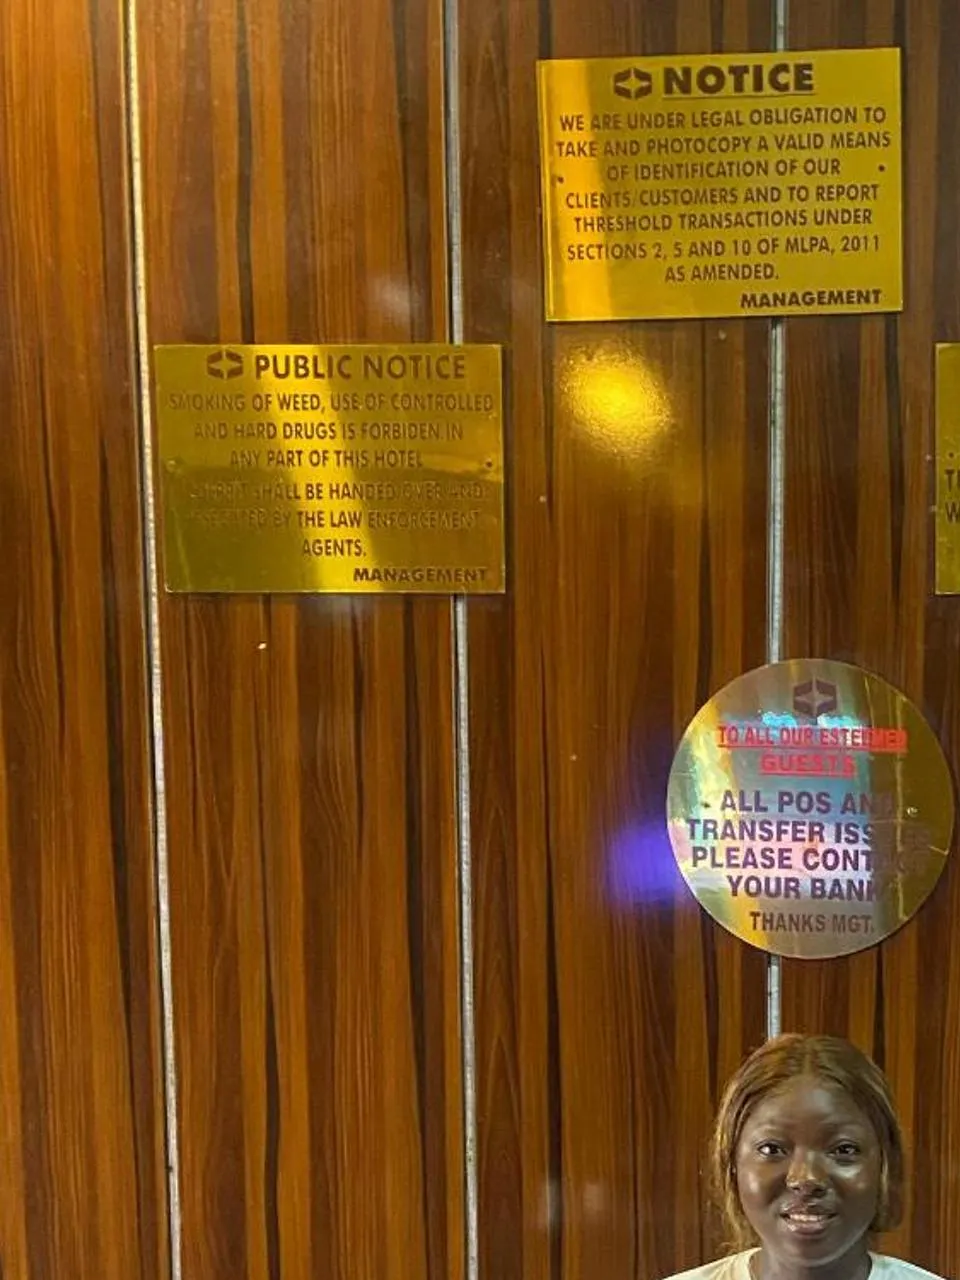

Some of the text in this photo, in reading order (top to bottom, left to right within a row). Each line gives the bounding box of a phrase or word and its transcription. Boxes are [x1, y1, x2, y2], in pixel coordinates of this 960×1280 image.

[663, 63, 814, 95] NOTICE
[560, 107, 886, 131] WE ARE UNDER LEGAL OBLIGATION TO
[557, 132, 891, 157] TAKE AND PHOTOCOPY A VALID MEANS
[607, 159, 841, 181] OF IDENTIFICATION OF OUR
[744, 187, 780, 203] AND
[788, 186, 810, 202] TO
[816, 184, 878, 201] REPORT
[574, 209, 872, 232] THRESHOLD TRANSACTIONS UNDER
[568, 236, 880, 261] SECTIONS 2, 5 AND 10 OF MLPA, 2011
[665, 264, 779, 282] AS AMENDED.
[740, 289, 882, 309] MANAGEMENT
[255, 355, 467, 380] PUBLIC NOTICE
[169, 393, 493, 413] SMOKING OF WEED, USE OF CONTROLLED
[195, 423, 228, 439] AND
[234, 423, 277, 439] HARD
[283, 423, 336, 439] DRUGS
[342, 423, 355, 439] IS
[447, 423, 463, 439] IN
[230, 451, 423, 467] ANY PART OF THIS HOTEL
[306, 483, 323, 499] BE
[329, 483, 395, 500] HANDED
[297, 512, 325, 528] THE
[331, 512, 362, 528] LAW
[302, 539, 367, 557] AGENTS.
[353, 568, 488, 582] MANAGEMENT
[718, 727, 738, 746] TO
[745, 727, 774, 746] ALL
[781, 727, 814, 746] OUR
[760, 755, 857, 776] GUESTS
[720, 790, 894, 814] ALL POS AN
[687, 819, 825, 842] TRANSFER
[692, 847, 792, 870] PLEASE
[726, 876, 801, 898] YOUR
[750, 912, 825, 932] THANKS
